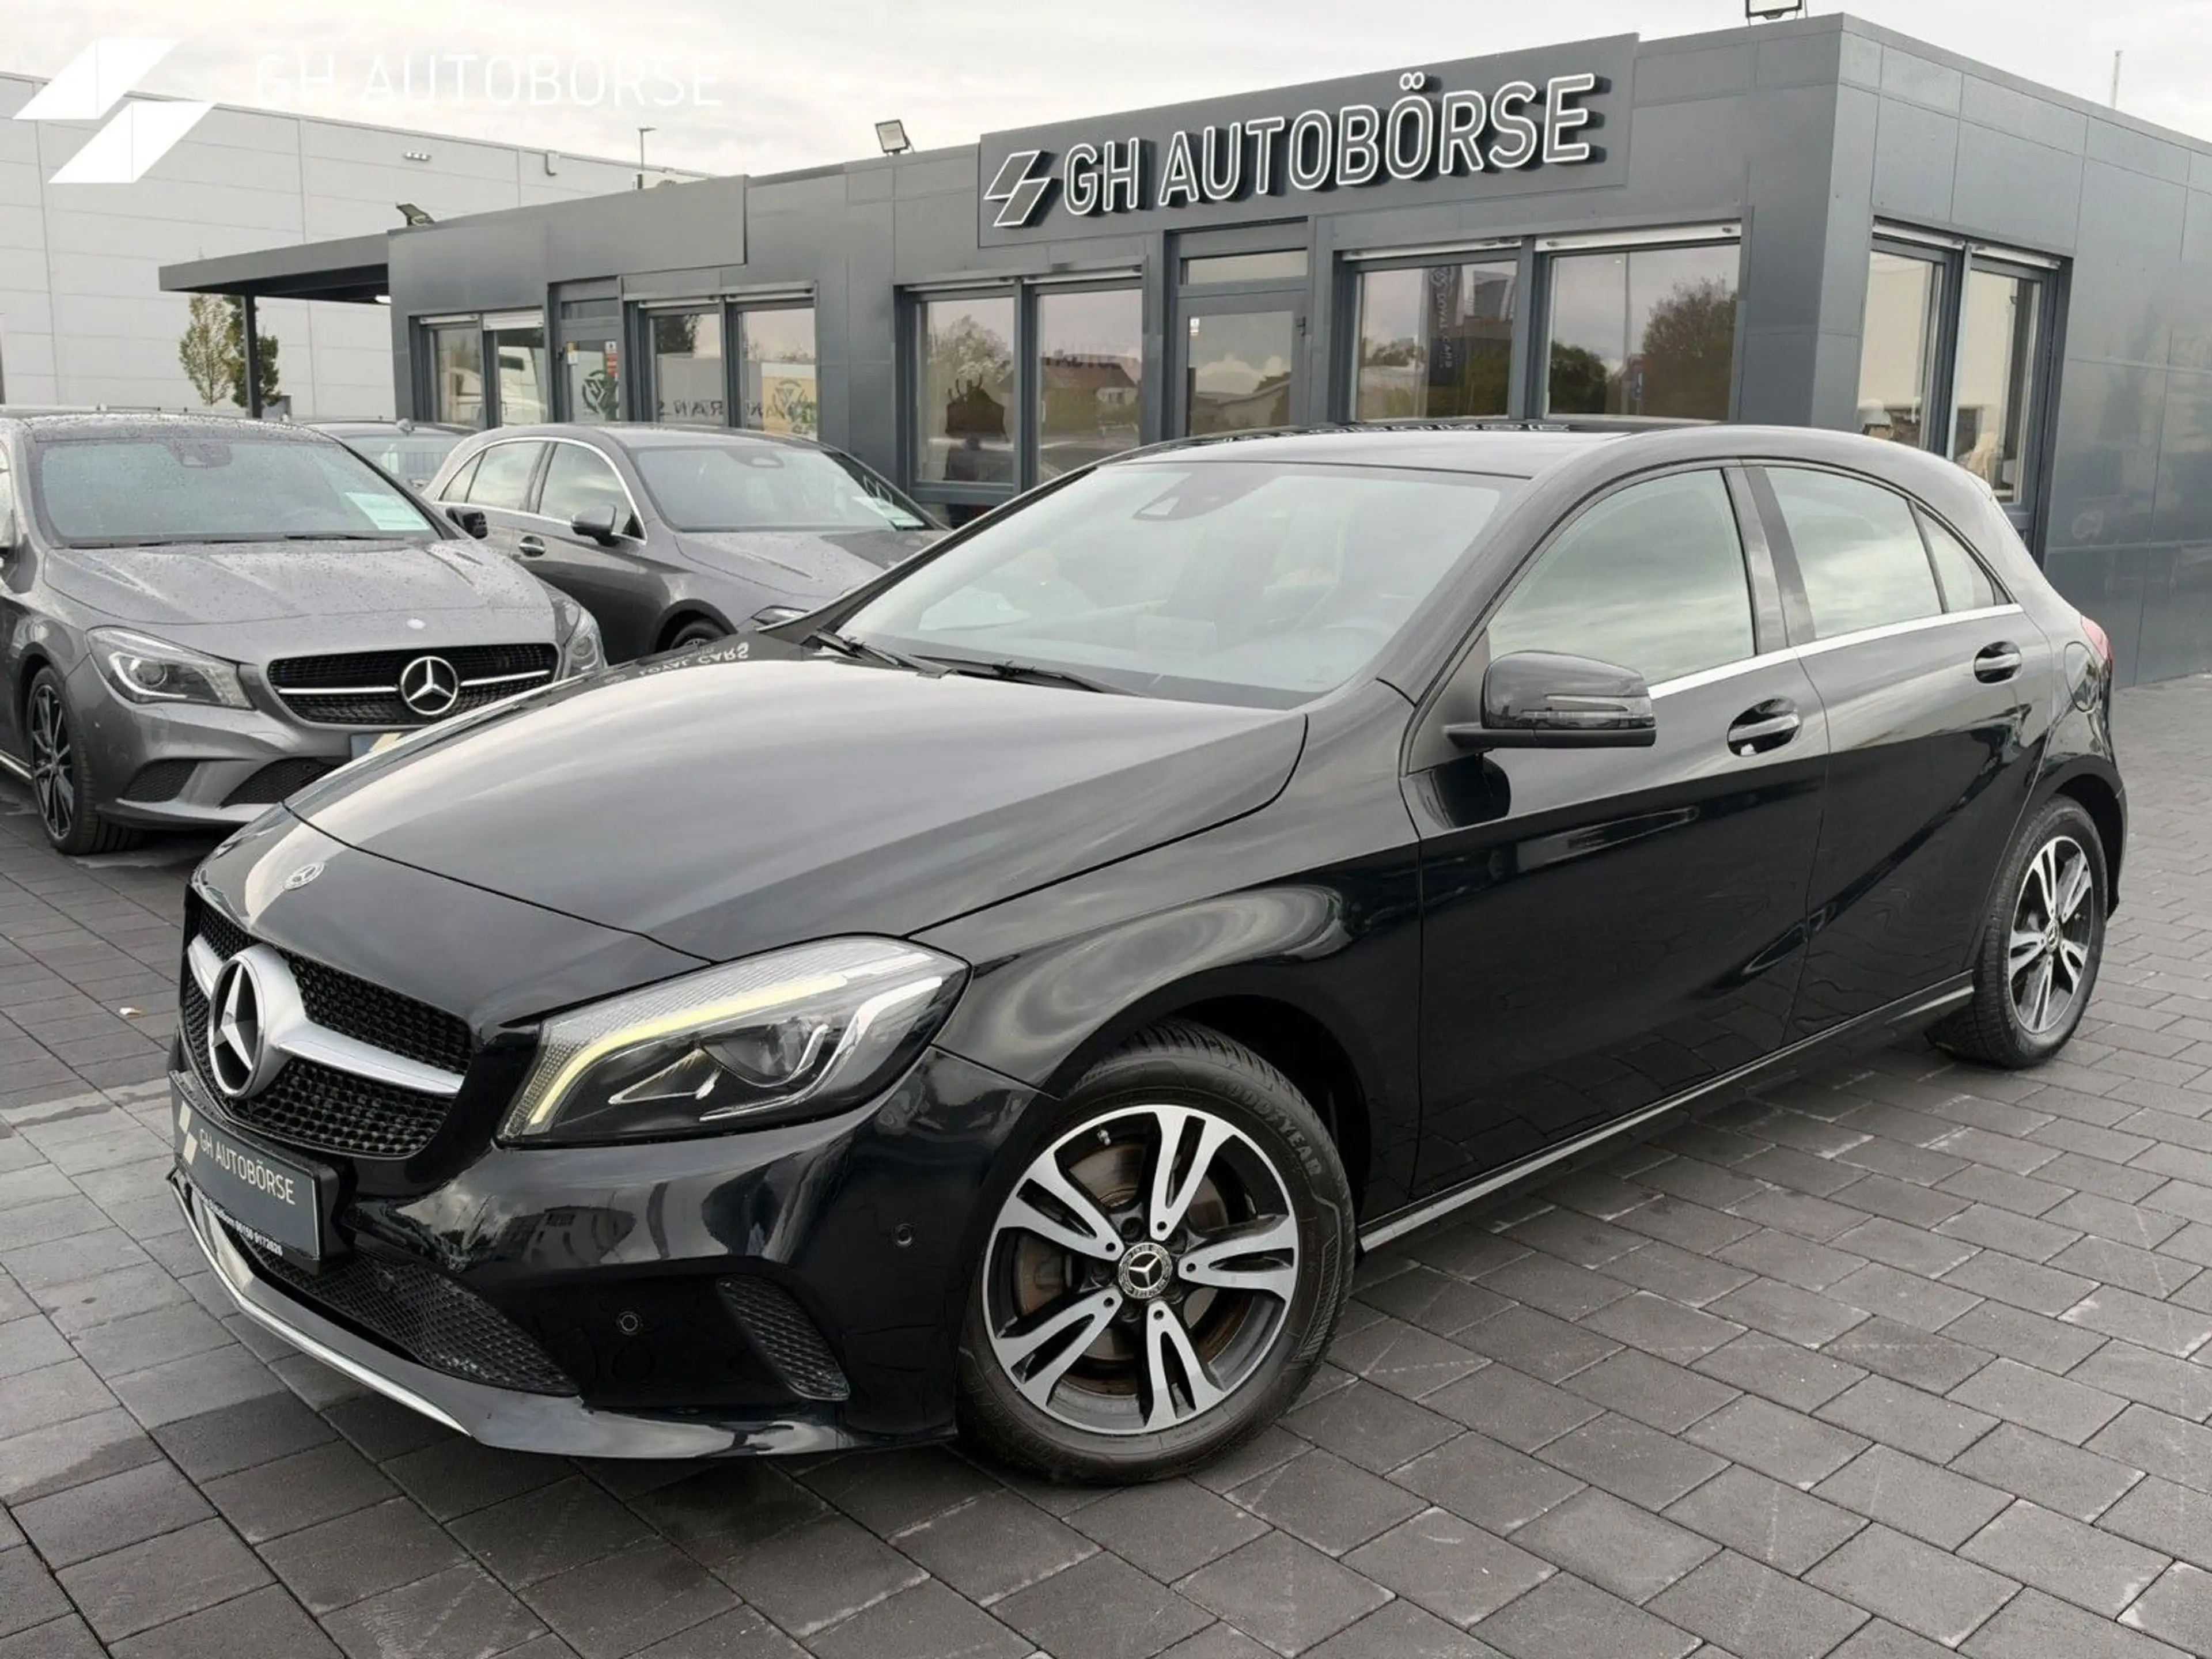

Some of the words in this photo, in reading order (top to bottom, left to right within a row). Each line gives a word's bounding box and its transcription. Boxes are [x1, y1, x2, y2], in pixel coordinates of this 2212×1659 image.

[1064, 137, 1139, 215] GH
[1158, 71, 1594, 207] AUTOBÖRSE
[200, 1128, 214, 1158] GH
[215, 1141, 296, 1205] AUTOBÖRSE
